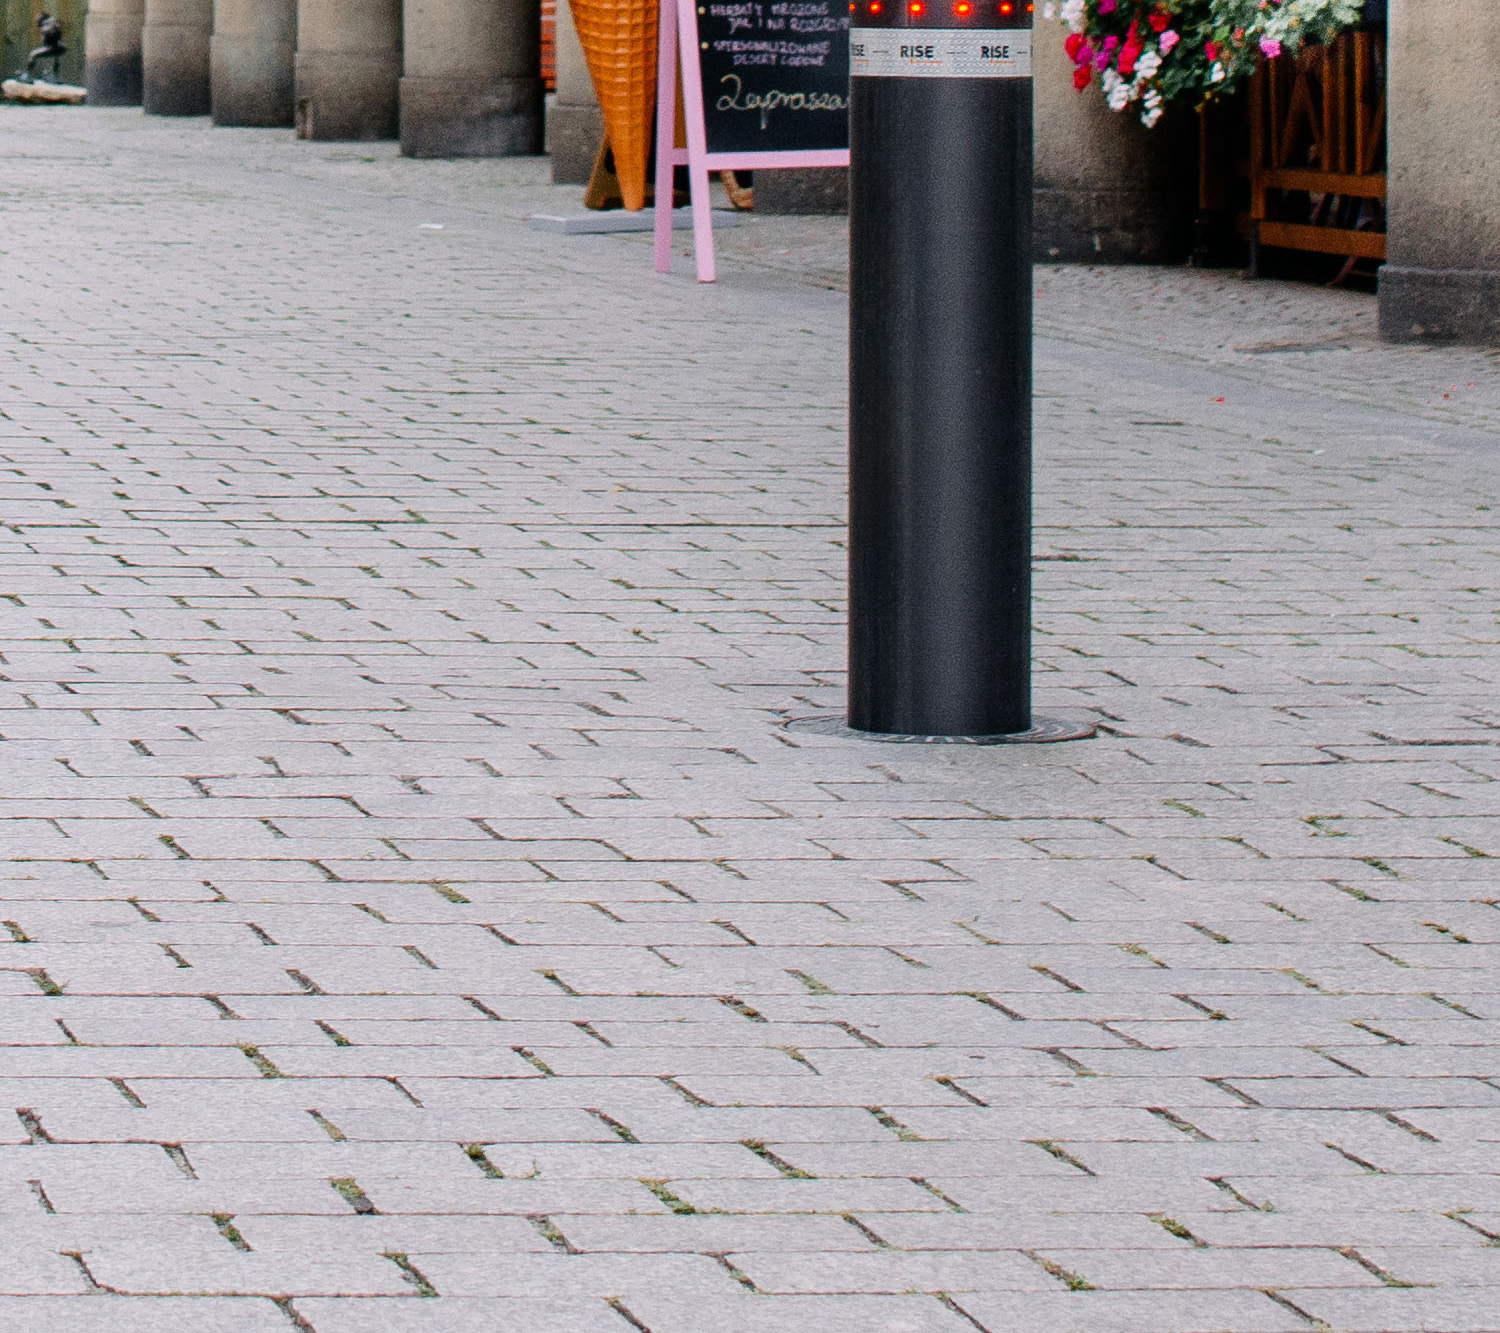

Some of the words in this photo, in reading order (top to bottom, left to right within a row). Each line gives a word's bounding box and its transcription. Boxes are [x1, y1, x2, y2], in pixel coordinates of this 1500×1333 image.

[900, 44, 935, 58] RISE
[980, 44, 1010, 58] RISE
[716, 73, 850, 130] Zaprasza
